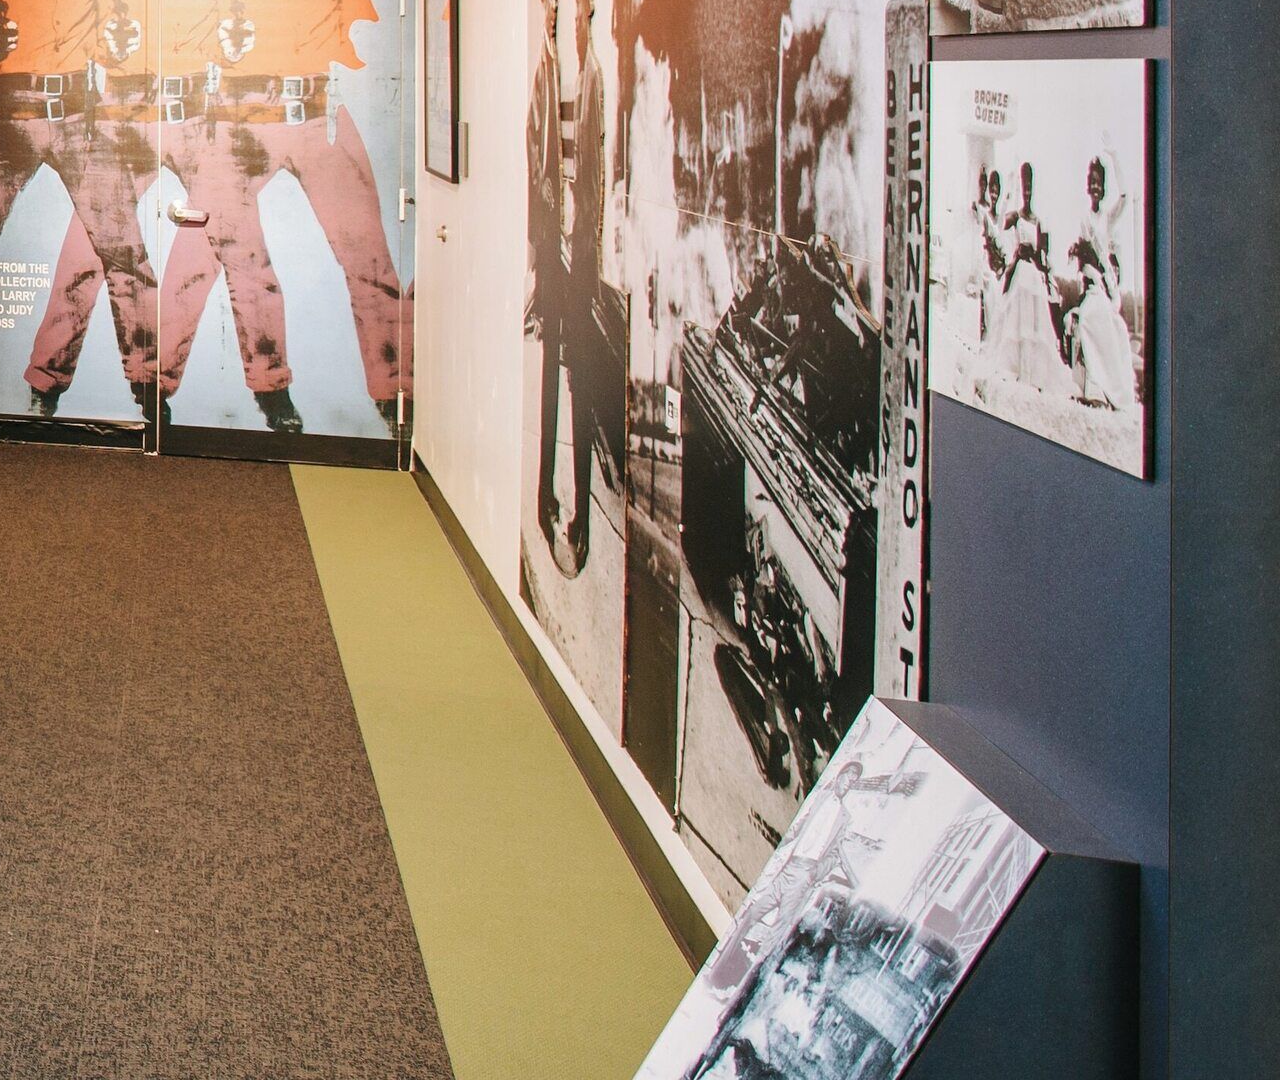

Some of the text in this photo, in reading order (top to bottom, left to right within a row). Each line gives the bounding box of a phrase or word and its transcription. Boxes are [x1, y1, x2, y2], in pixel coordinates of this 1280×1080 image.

[974, 89, 1009, 108] BRONZE
[974, 106, 1006, 126] QUEEN
[28, 263, 49, 275] THE
[1, 290, 37, 302] LARRY
[903, 63, 922, 529] HERNANDO
[6, 304, 34, 316] JUDY
